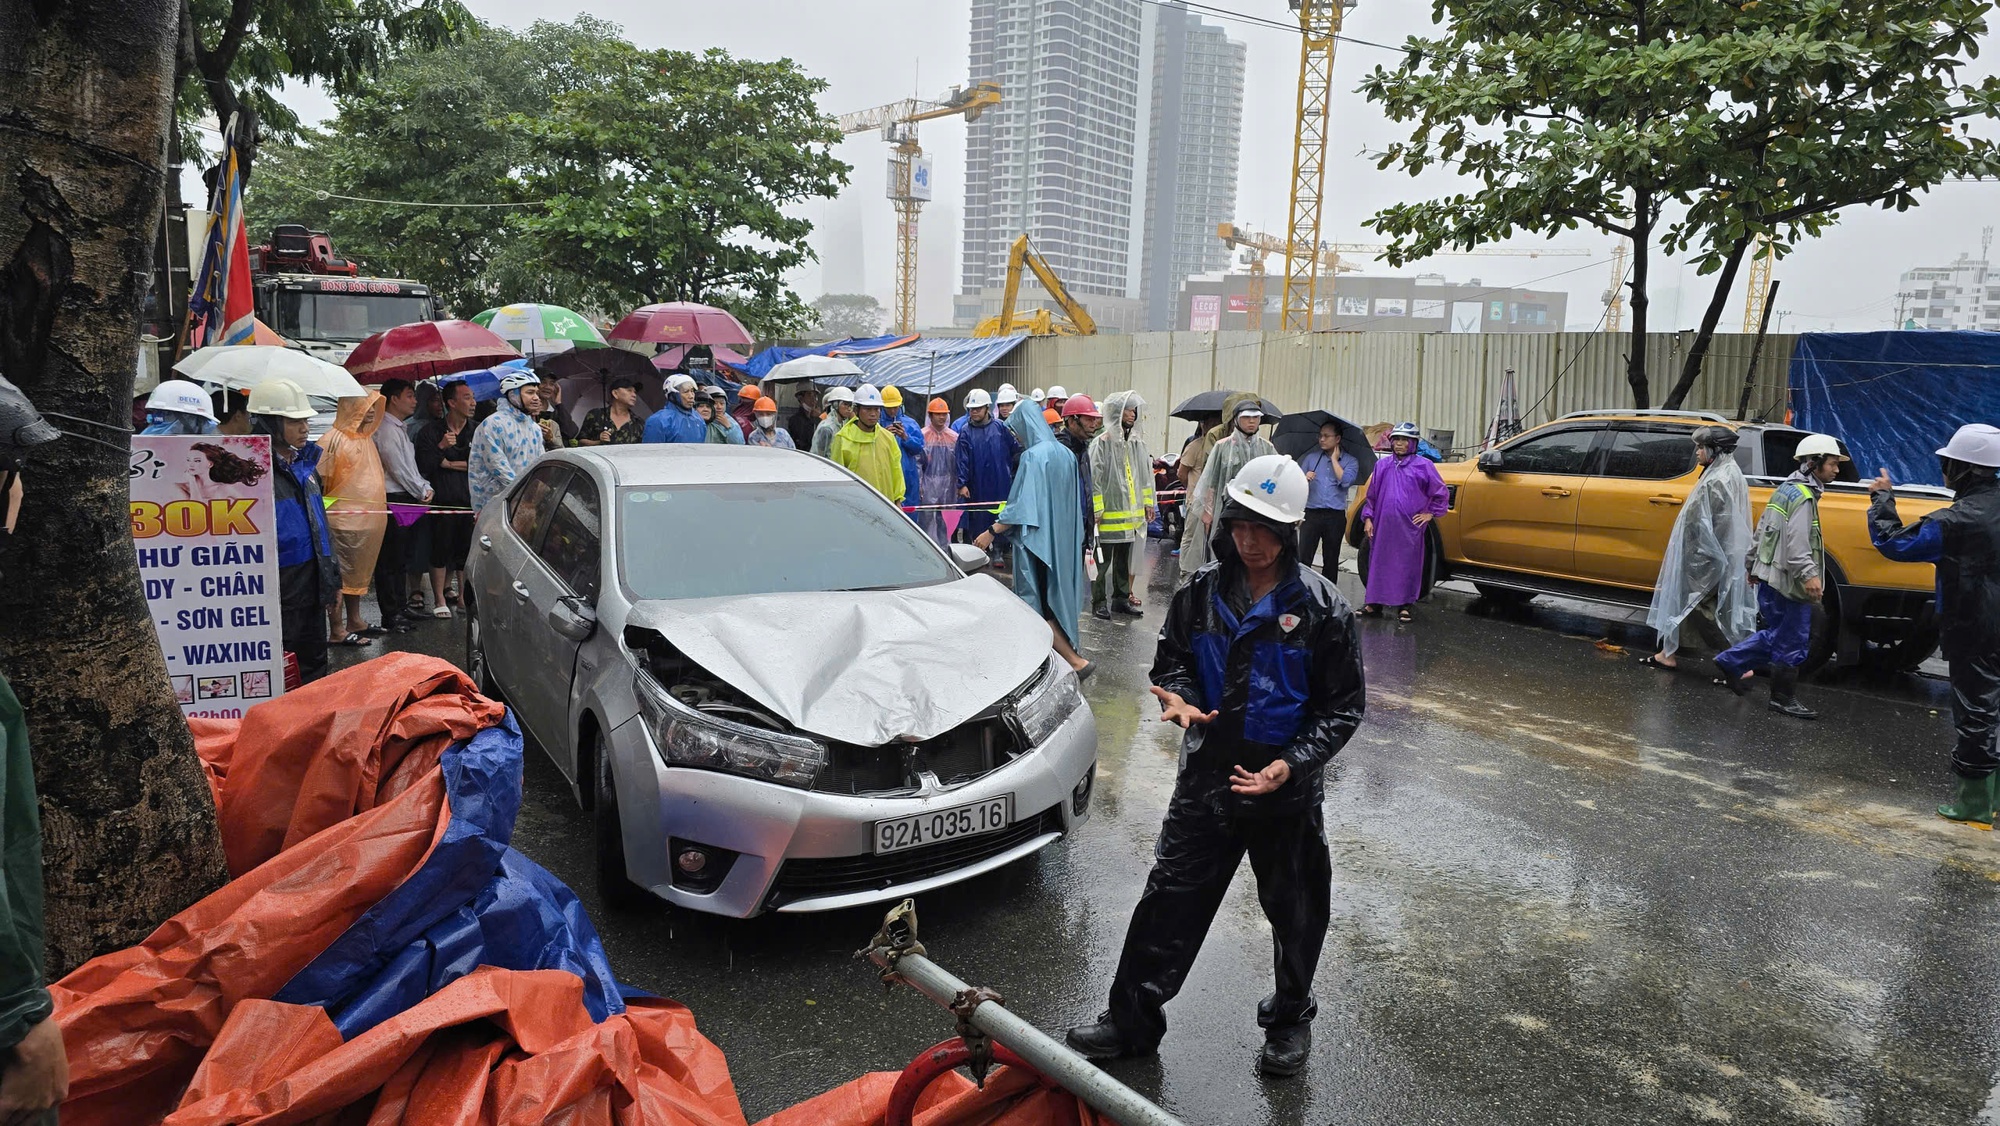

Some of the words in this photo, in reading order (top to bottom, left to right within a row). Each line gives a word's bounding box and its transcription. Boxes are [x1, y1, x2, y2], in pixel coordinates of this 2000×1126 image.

[179, 395, 201, 405] DELTA
[136, 545, 183, 568] HƯ
[191, 541, 264, 567] GIÃN
[200, 571, 264, 597] CHÂN
[177, 607, 223, 631] SƠN
[230, 606, 270, 627] GEL
[183, 640, 271, 665] WAXING
[881, 802, 1002, 850] 92A-035.16
